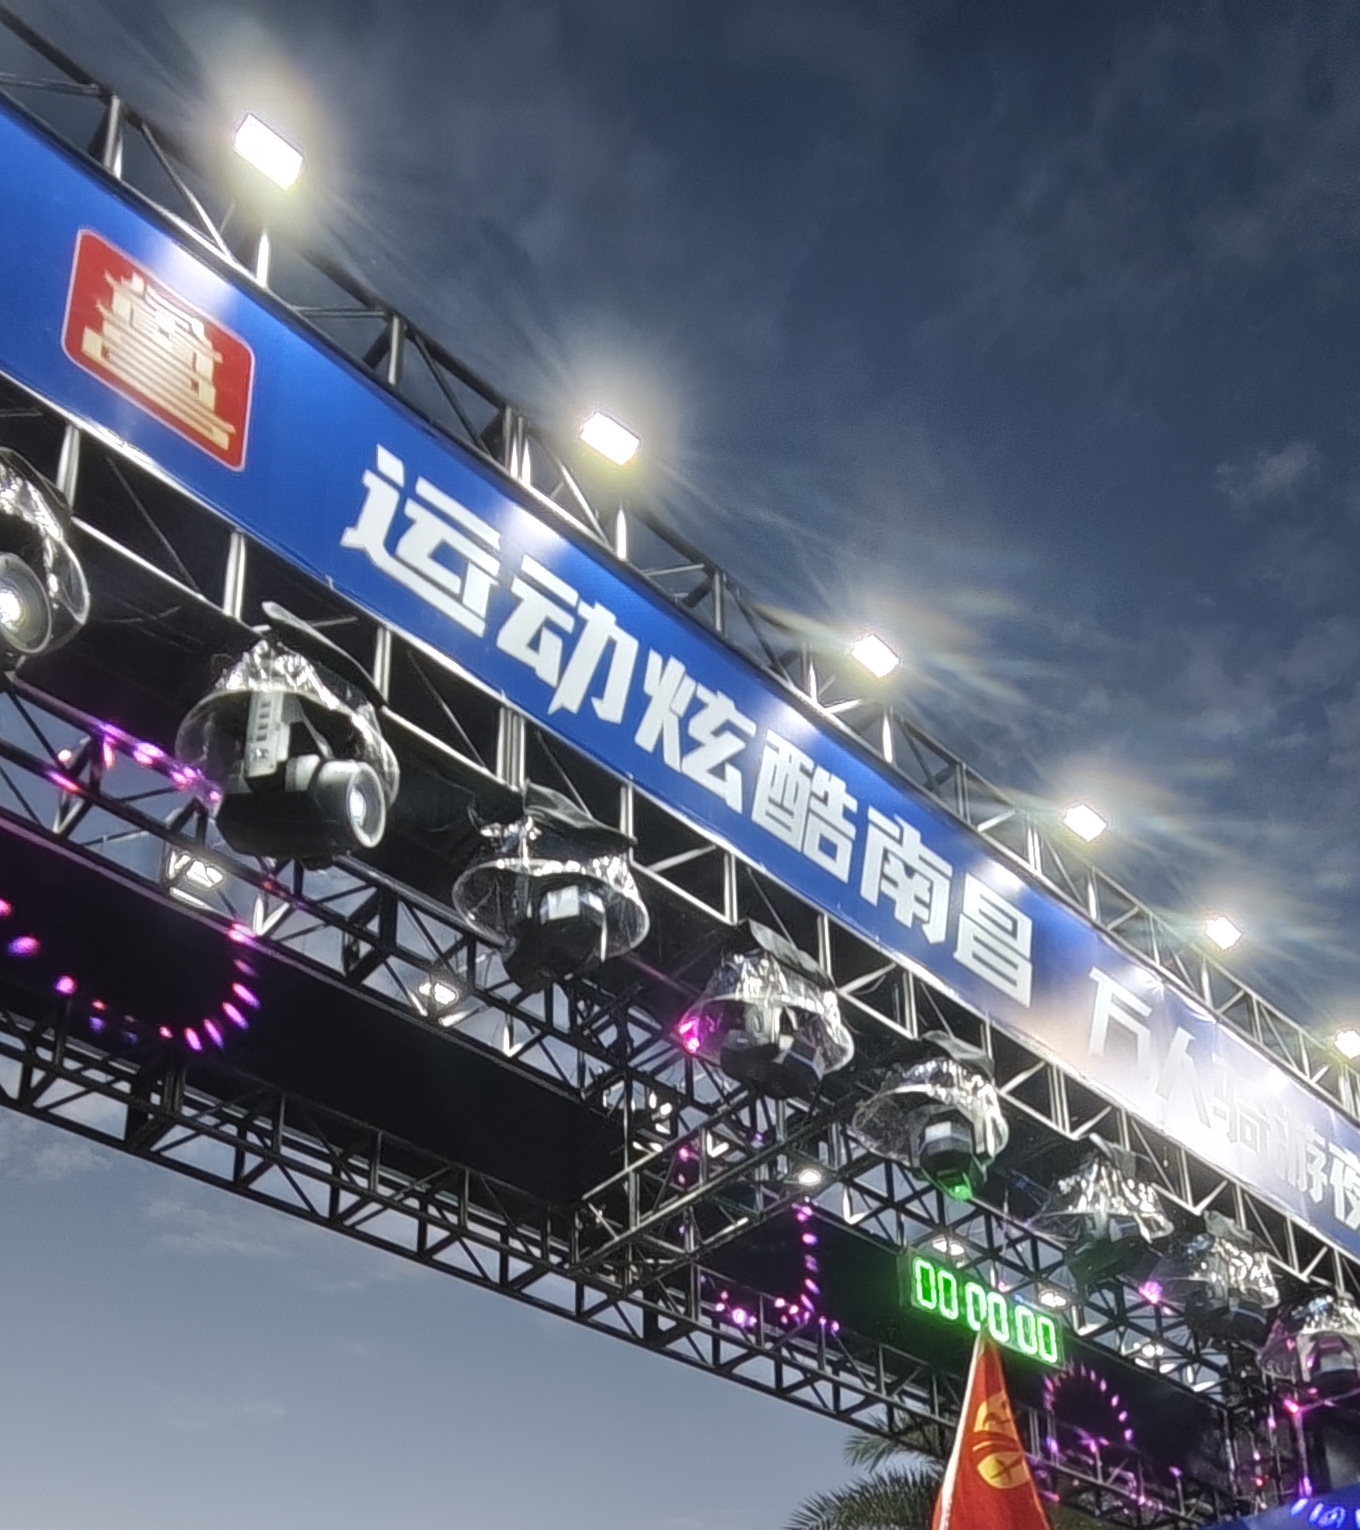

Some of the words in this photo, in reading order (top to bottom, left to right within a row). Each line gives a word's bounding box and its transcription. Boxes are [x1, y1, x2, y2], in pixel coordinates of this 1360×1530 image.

[340, 445, 1034, 1007] 运动炫酷南昌
